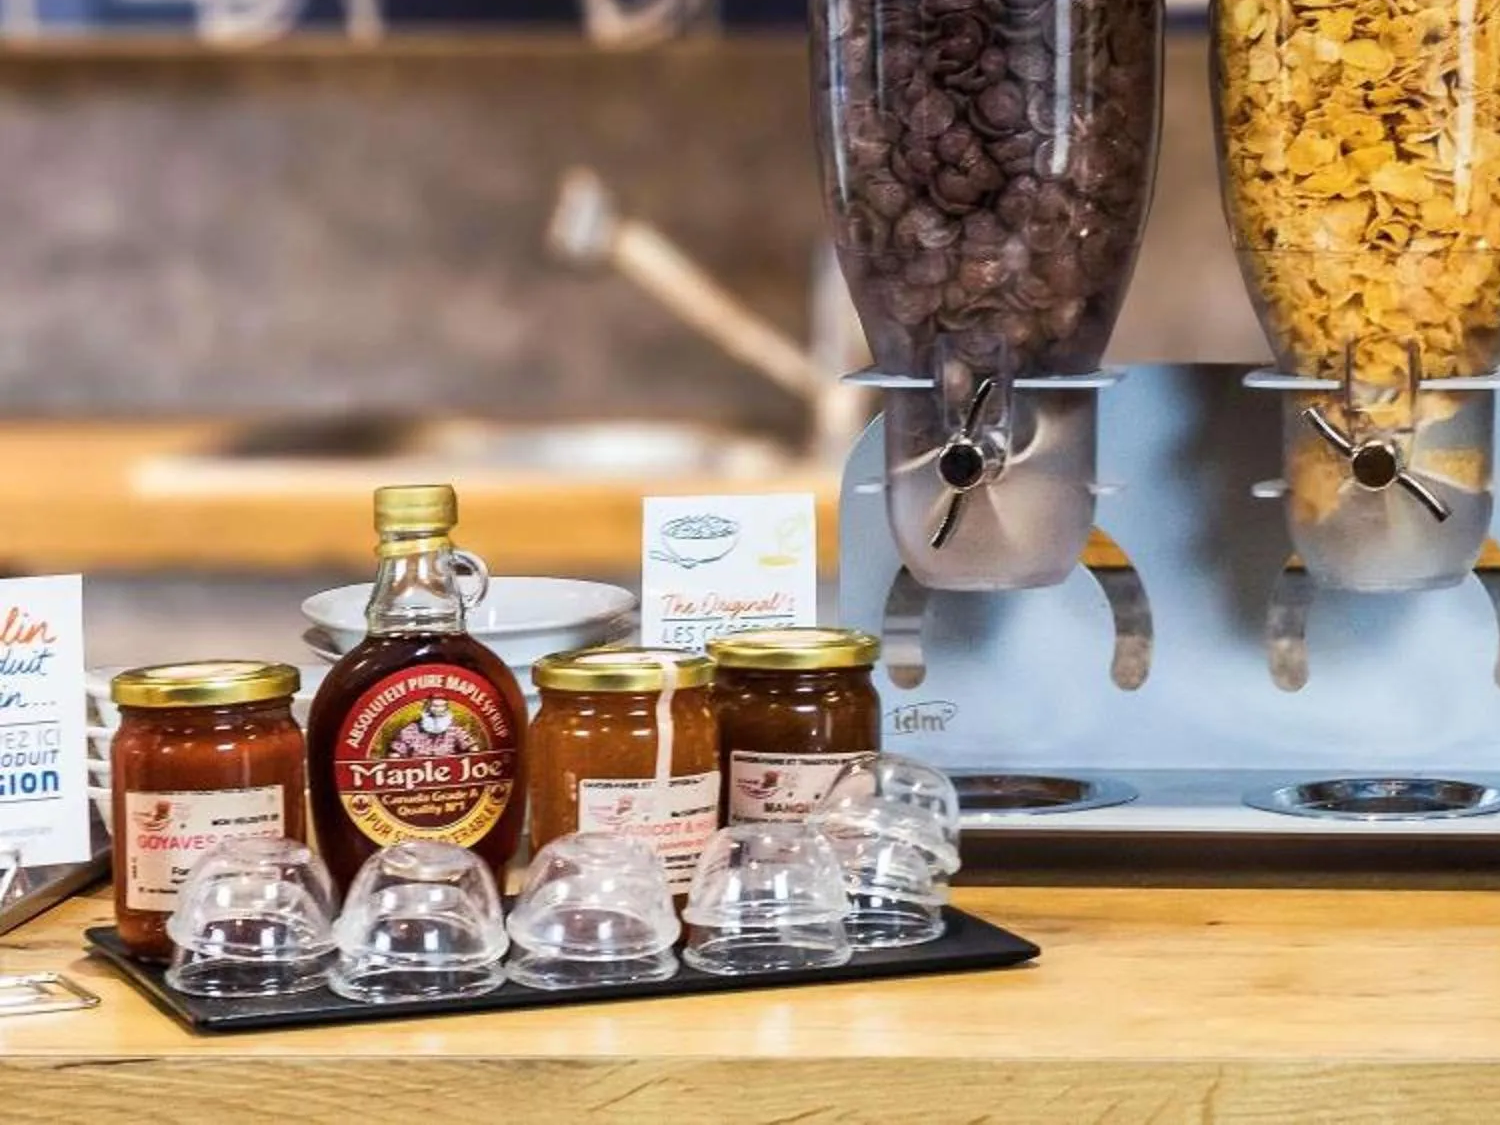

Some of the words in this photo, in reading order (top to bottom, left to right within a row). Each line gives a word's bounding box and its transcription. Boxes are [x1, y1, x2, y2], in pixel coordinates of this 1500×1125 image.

[346, 682, 407, 748] ABSOLUTELY
[407, 674, 445, 691] PURE
[445, 675, 486, 706] MAPLE
[350, 761, 450, 789] Maple
[458, 757, 503, 782] Joe
